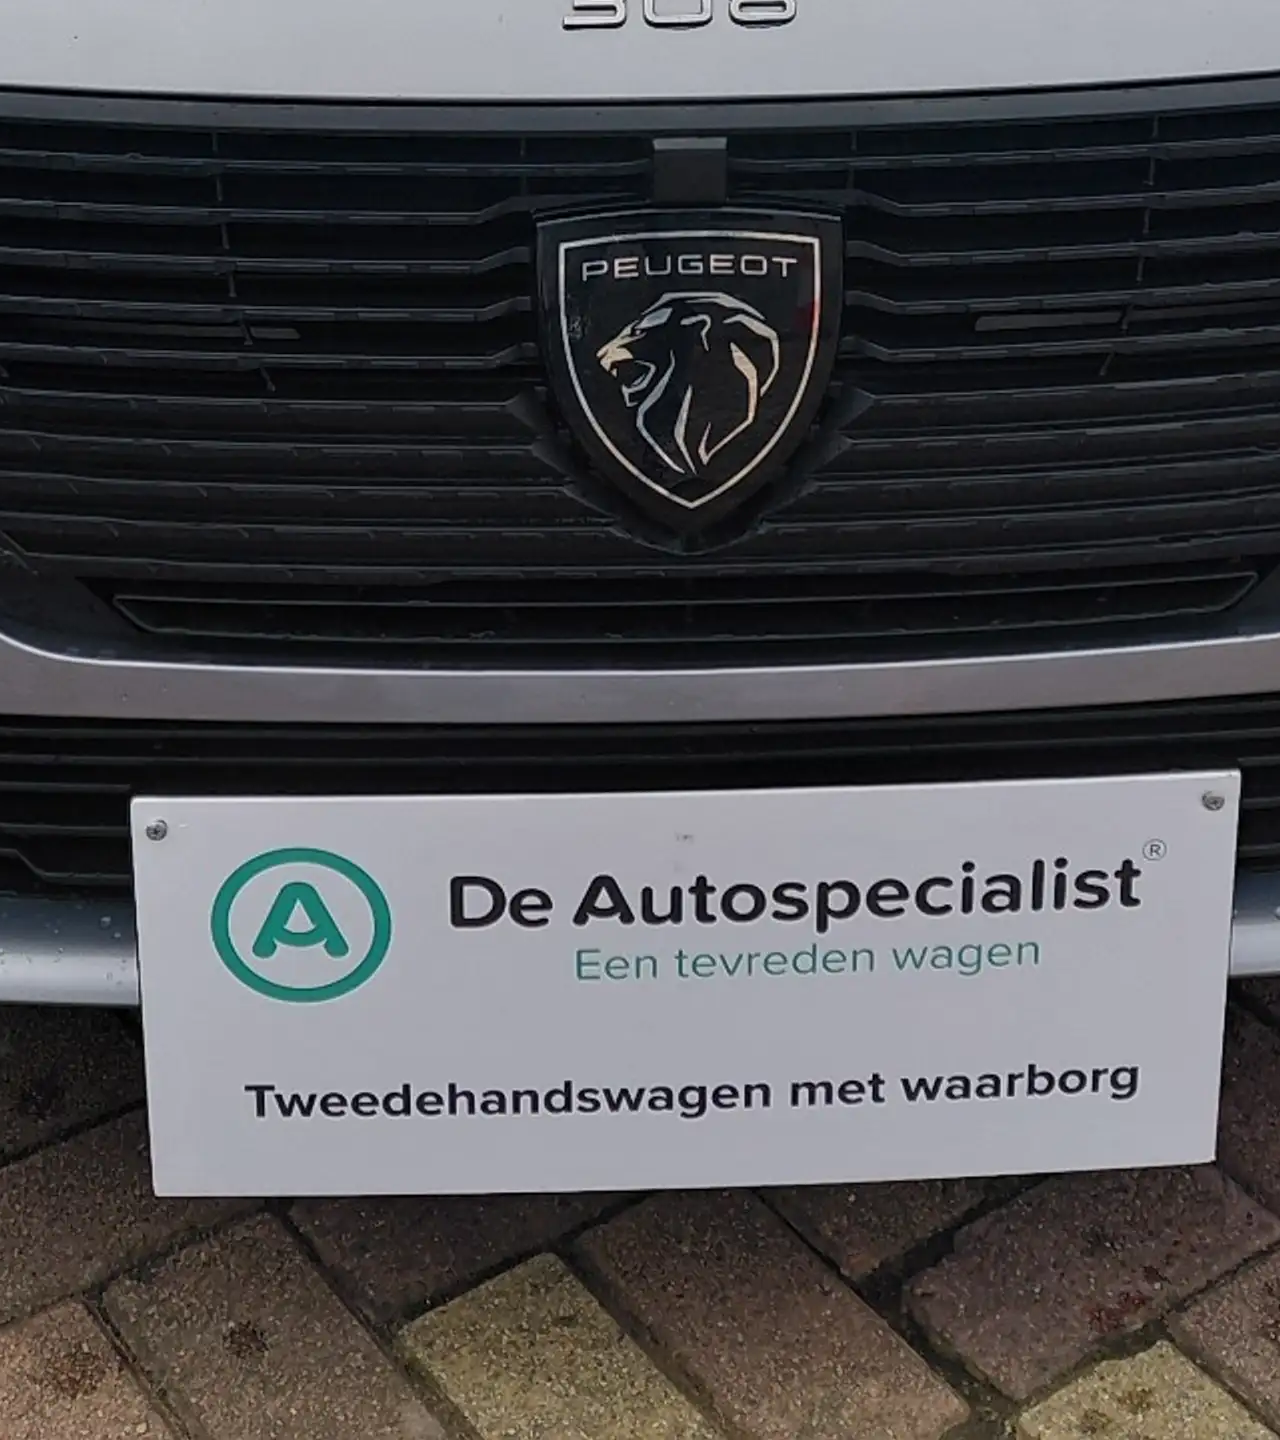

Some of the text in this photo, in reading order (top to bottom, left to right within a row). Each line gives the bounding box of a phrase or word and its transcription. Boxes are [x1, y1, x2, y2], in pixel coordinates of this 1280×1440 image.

[581, 254, 798, 282] PEUGEOT
[449, 875, 553, 929] De
[572, 857, 1142, 934] Autospecialist
[574, 941, 1040, 981] Een tevreden wagen
[244, 1063, 1140, 1119] Tweedehandswagen met waarborg
